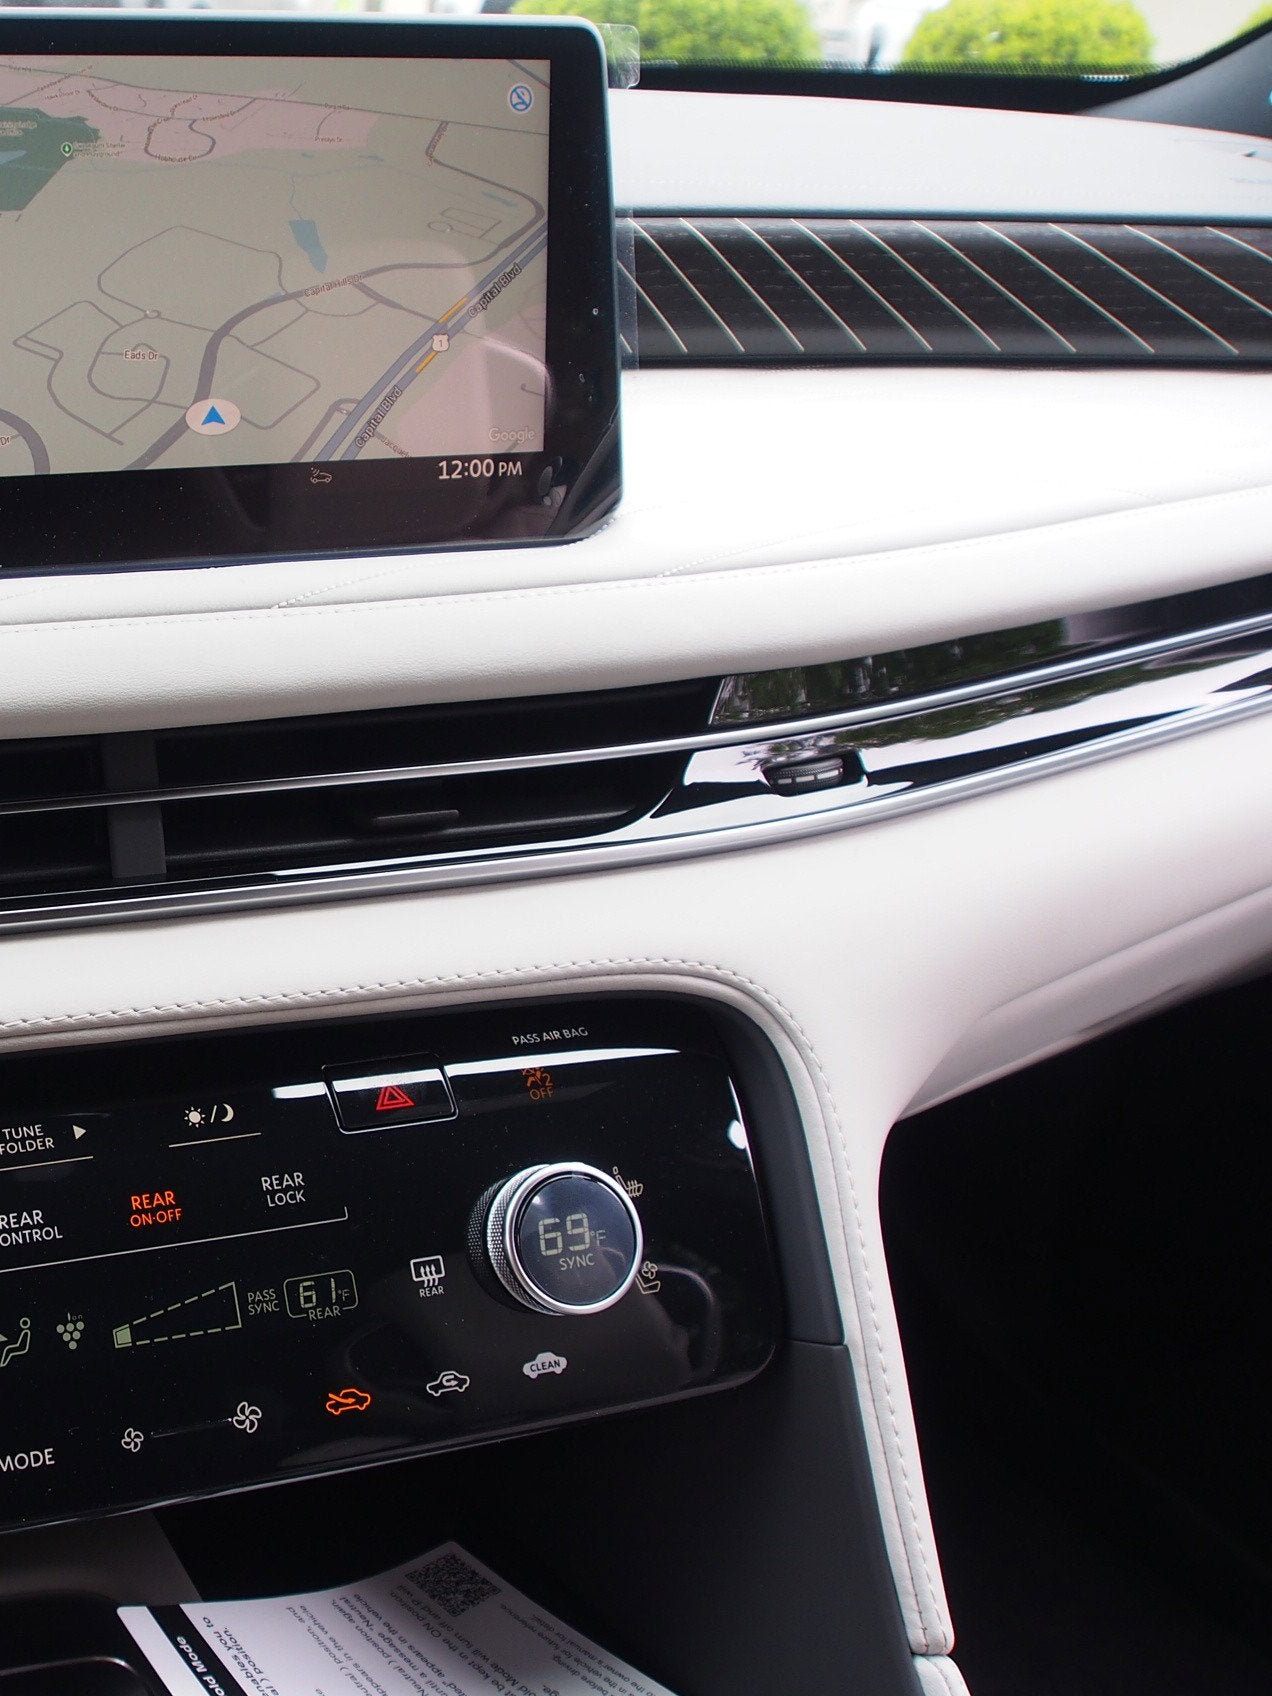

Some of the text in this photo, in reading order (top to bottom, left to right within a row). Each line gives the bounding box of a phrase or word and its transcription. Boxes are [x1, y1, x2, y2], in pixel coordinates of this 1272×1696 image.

[304, 274, 364, 297] Capital Hills Dr
[468, 263, 522, 318] Capital Blvd
[124, 350, 159, 360] Eads Dr
[355, 386, 403, 448] Capital Blvd
[0, 436, 10, 446] Dr
[488, 427, 535, 443] Google
[380, 437, 413, 458] Jacquel
[438, 458, 523, 479] 12:00 PM
[512, 1027, 588, 1045] PASS AIR BAG
[529, 1087, 553, 1100] OFF
[2, 1124, 44, 1140] TUNE
[261, 1172, 305, 1191] REAR
[130, 1190, 176, 1211] REAR
[267, 1189, 306, 1207] LOCK
[538, 1212, 591, 1257] 69
[559, 1253, 596, 1271] SYNC
[247, 1289, 276, 1303] PASS
[299, 1277, 336, 1309] 61
[418, 1286, 445, 1298] REAR
[247, 1300, 280, 1316] SYNC
[308, 1305, 342, 1321] REAR
[529, 1359, 561, 1373] CLEAN
[286, 1607, 306, 1623] and
[353, 1593, 382, 1621] vehicle
[202, 1616, 214, 1628] to
[300, 1605, 328, 1635] vehicle
[383, 1621, 398, 1635] the
[422, 1622, 442, 1638] ON
[213, 1630, 233, 1651] you
[329, 1636, 343, 1651] the
[355, 1625, 391, 1659] position
[398, 1636, 408, 1644] in
[442, 1638, 458, 1652] the
[454, 1632, 474, 1649] turn
[176, 1635, 208, 1674] Mode
[224, 1626, 263, 1675] position.
[343, 1653, 353, 1661] in
[378, 1632, 419, 1671] message
[459, 1652, 469, 1660] in
[472, 1648, 489, 1662] will
[561, 1648, 574, 1659] for
[568, 1640, 597, 1660] manual
[408, 1645, 445, 1678] appears
[468, 1660, 490, 1680] kept
[573, 1657, 603, 1679] vehicle
[490, 1662, 519, 1686] Mode
[491, 1679, 505, 1692] be
[581, 1675, 608, 1695] before
[603, 1677, 618, 1689] the
[630, 1681, 646, 1693] the
